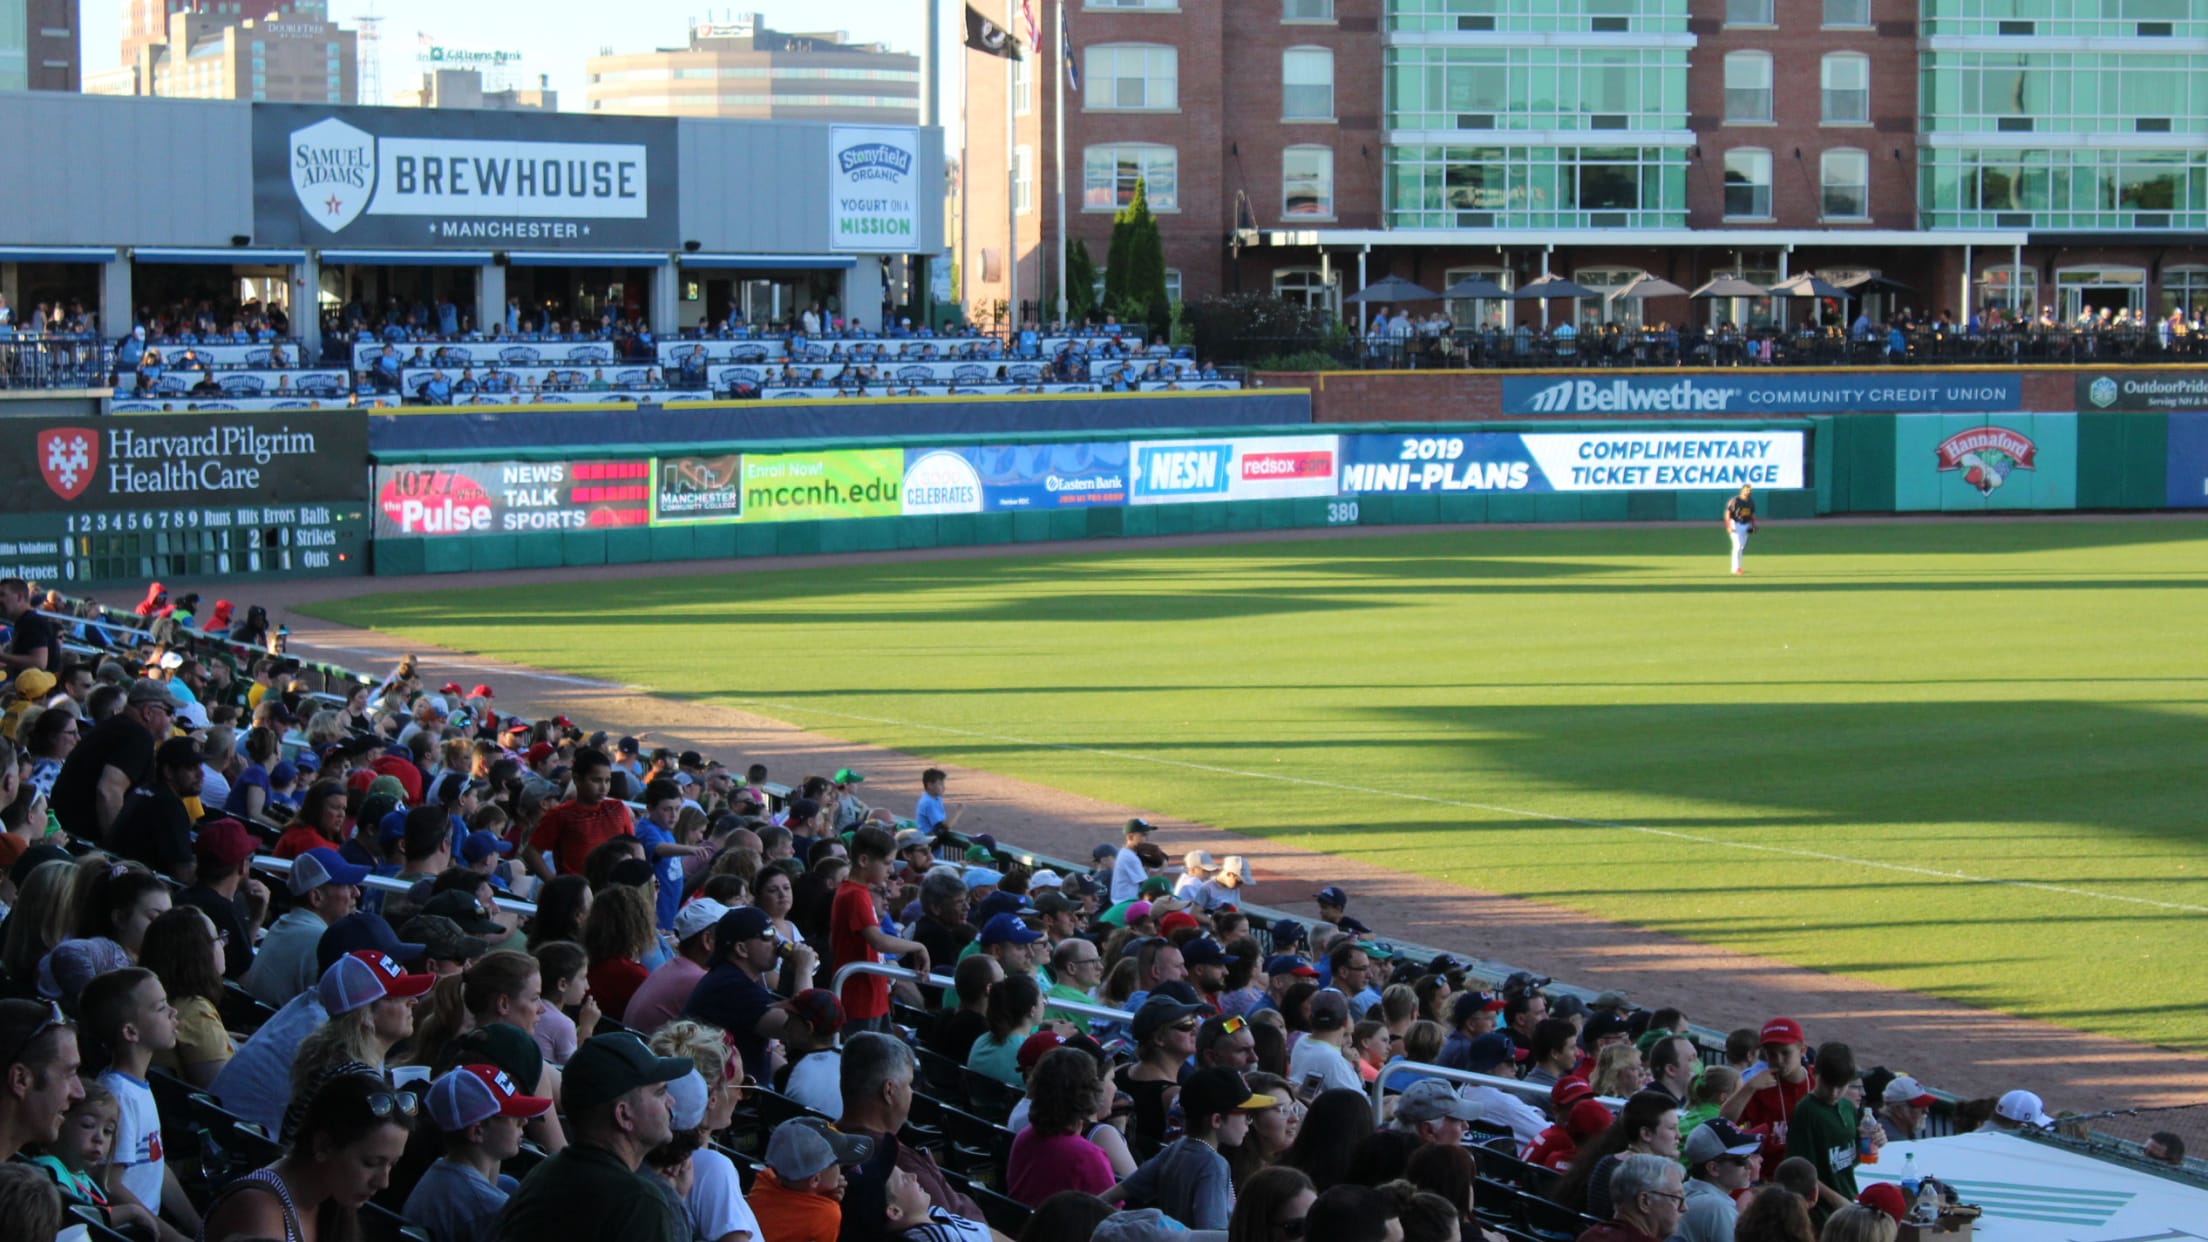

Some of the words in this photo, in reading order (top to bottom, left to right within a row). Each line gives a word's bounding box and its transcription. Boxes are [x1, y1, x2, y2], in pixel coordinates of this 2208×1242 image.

[296, 144, 371, 169] SAMUEL
[842, 145, 909, 171] Stonyfield
[303, 166, 365, 189] ADAMS
[396, 155, 637, 198] BREWHOUSE
[851, 168, 899, 183] ORGANIC
[841, 199, 888, 211] YOGURT
[891, 199, 903, 211] ON
[904, 199, 910, 211] A
[443, 222, 578, 238] MANCHESTER
[840, 217, 911, 235] MISSION
[1576, 379, 1735, 411] Bellwether
[1750, 390, 1865, 403] COMMUNITY
[1869, 388, 1940, 402] CREDIT
[1947, 388, 2007, 401] UNION
[108, 426, 219, 460] Harvard
[222, 426, 315, 464] Pilgrim
[1400, 438, 1464, 460] 2019
[1578, 440, 1773, 460] COMPLIMENTARY
[1945, 430, 2029, 458] Hannaford
[503, 465, 563, 485] NEWS
[747, 462, 786, 479] Enroll
[788, 461, 823, 478] Now!
[1150, 451, 1218, 489] NESN
[1244, 455, 1330, 475] redsox.com
[1571, 466, 1650, 485] TICKET
[1656, 465, 1779, 484] EXCHANGE
[109, 461, 198, 494] Health
[200, 460, 260, 490] Care
[394, 469, 457, 497] 107.7
[1058, 478, 1095, 490] Eastern
[1096, 476, 1122, 489] Bank
[1342, 462, 1530, 492] MINI-PLANS
[503, 488, 559, 508] TALK
[661, 492, 737, 504] MANCHESTER
[747, 477, 898, 508] mccnh.edu
[907, 486, 974, 505] CELEBRATES
[67, 515, 74, 532] 1
[81, 514, 91, 531] 2
[97, 514, 107, 531] 3
[112, 513, 122, 530] 4
[127, 512, 137, 530] 5
[143, 512, 153, 529] 6
[159, 511, 169, 528] 7
[174, 510, 184, 527] 8
[188, 509, 198, 527] 9
[204, 510, 231, 526] Runs
[237, 509, 259, 525] Hits
[264, 508, 296, 525] Errors
[300, 507, 330, 525] Balls
[384, 501, 402, 512] the
[402, 498, 493, 533] Pulse
[503, 510, 586, 530] SPORTS
[1327, 503, 1359, 522] 380
[81, 536, 89, 556] 1
[221, 531, 229, 549] 1
[250, 529, 261, 548] 2
[281, 528, 289, 546] 0
[296, 528, 336, 546] Strikes
[18, 565, 58, 580] Feroces
[66, 560, 74, 579] 0
[220, 553, 229, 573] 0
[282, 550, 291, 569] 1
[304, 550, 330, 568] Outs
